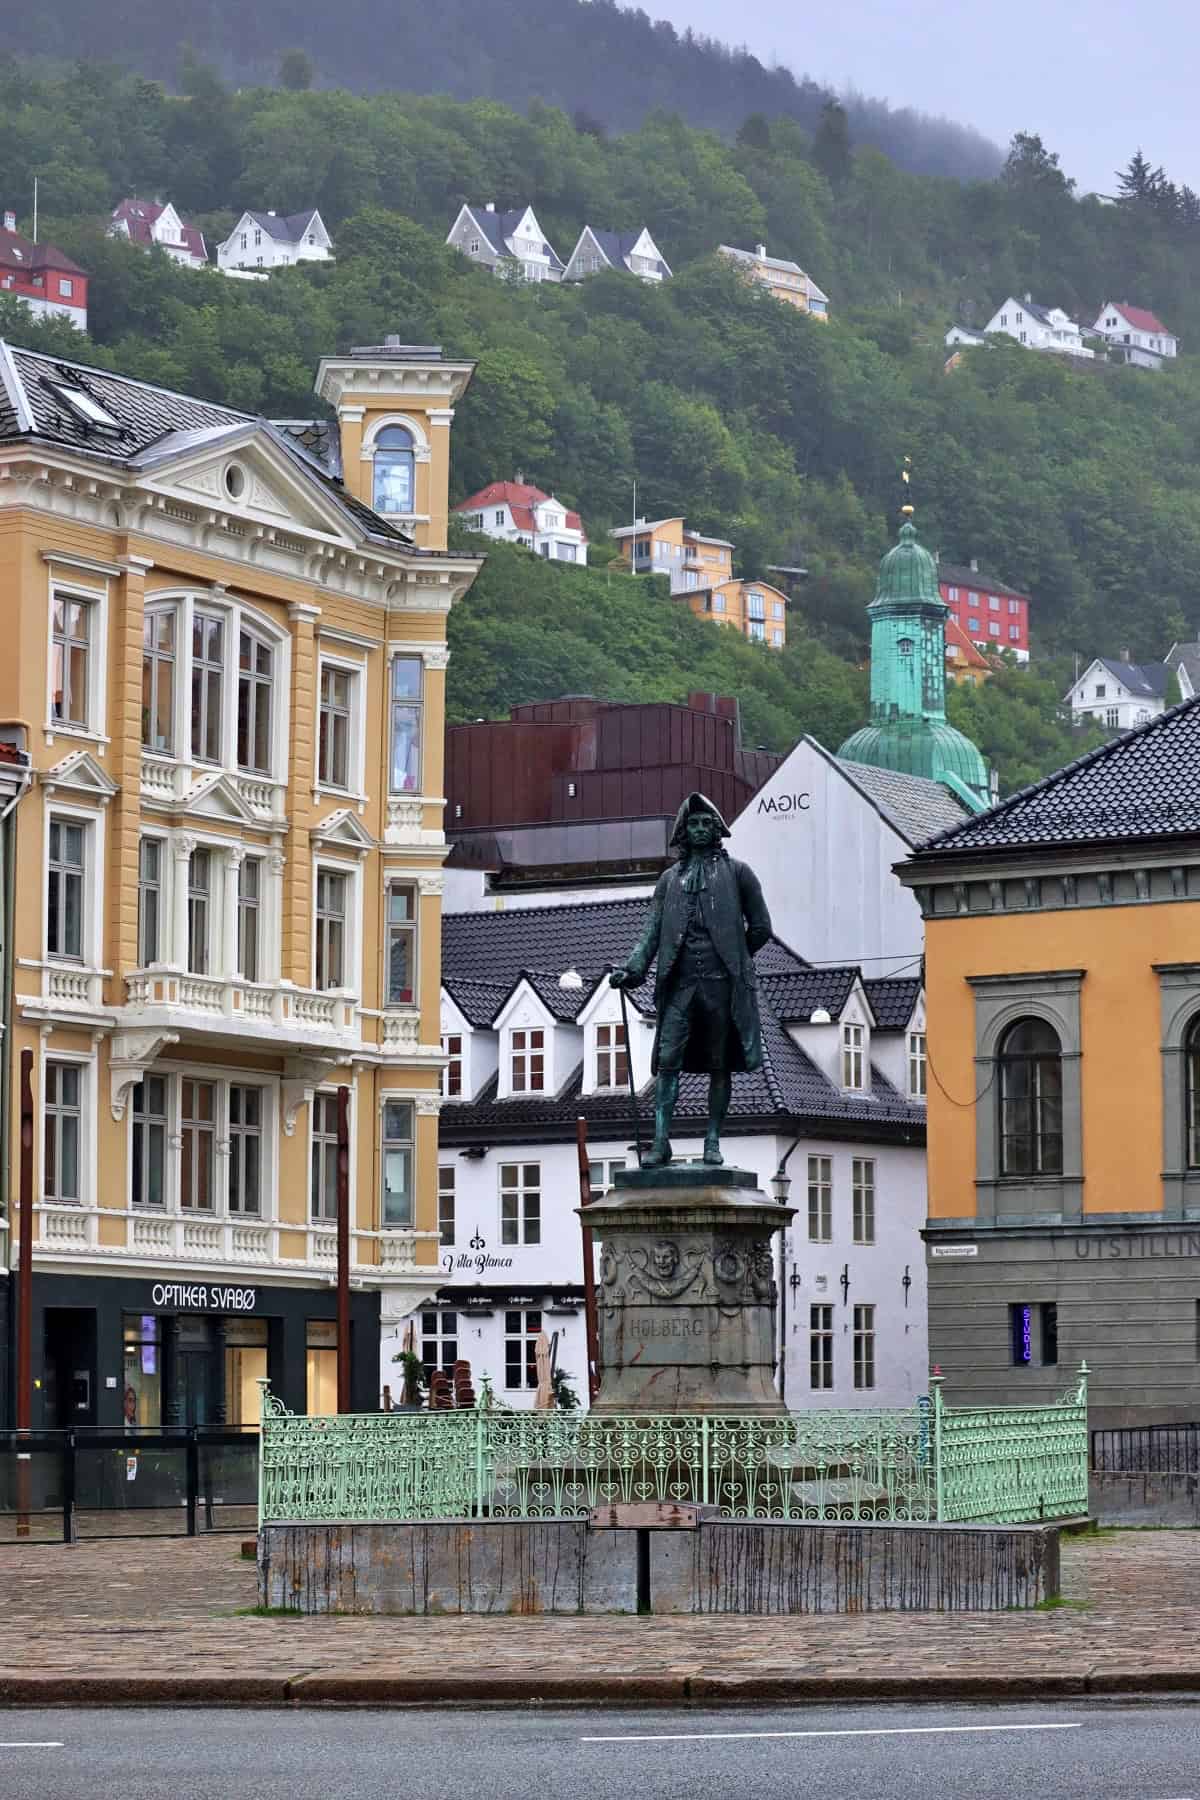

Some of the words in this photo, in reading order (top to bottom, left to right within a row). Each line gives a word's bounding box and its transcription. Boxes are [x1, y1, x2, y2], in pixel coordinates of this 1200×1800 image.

[758, 793, 810, 813] MAGIC
[442, 1253, 473, 1272] Villa
[474, 1253, 513, 1274] Blanca
[152, 1283, 207, 1306] OPTIKER
[210, 1287, 256, 1310] SVABØ
[631, 1318, 704, 1337] HOLBERG
[1023, 1308, 1031, 1360] STUDIO
